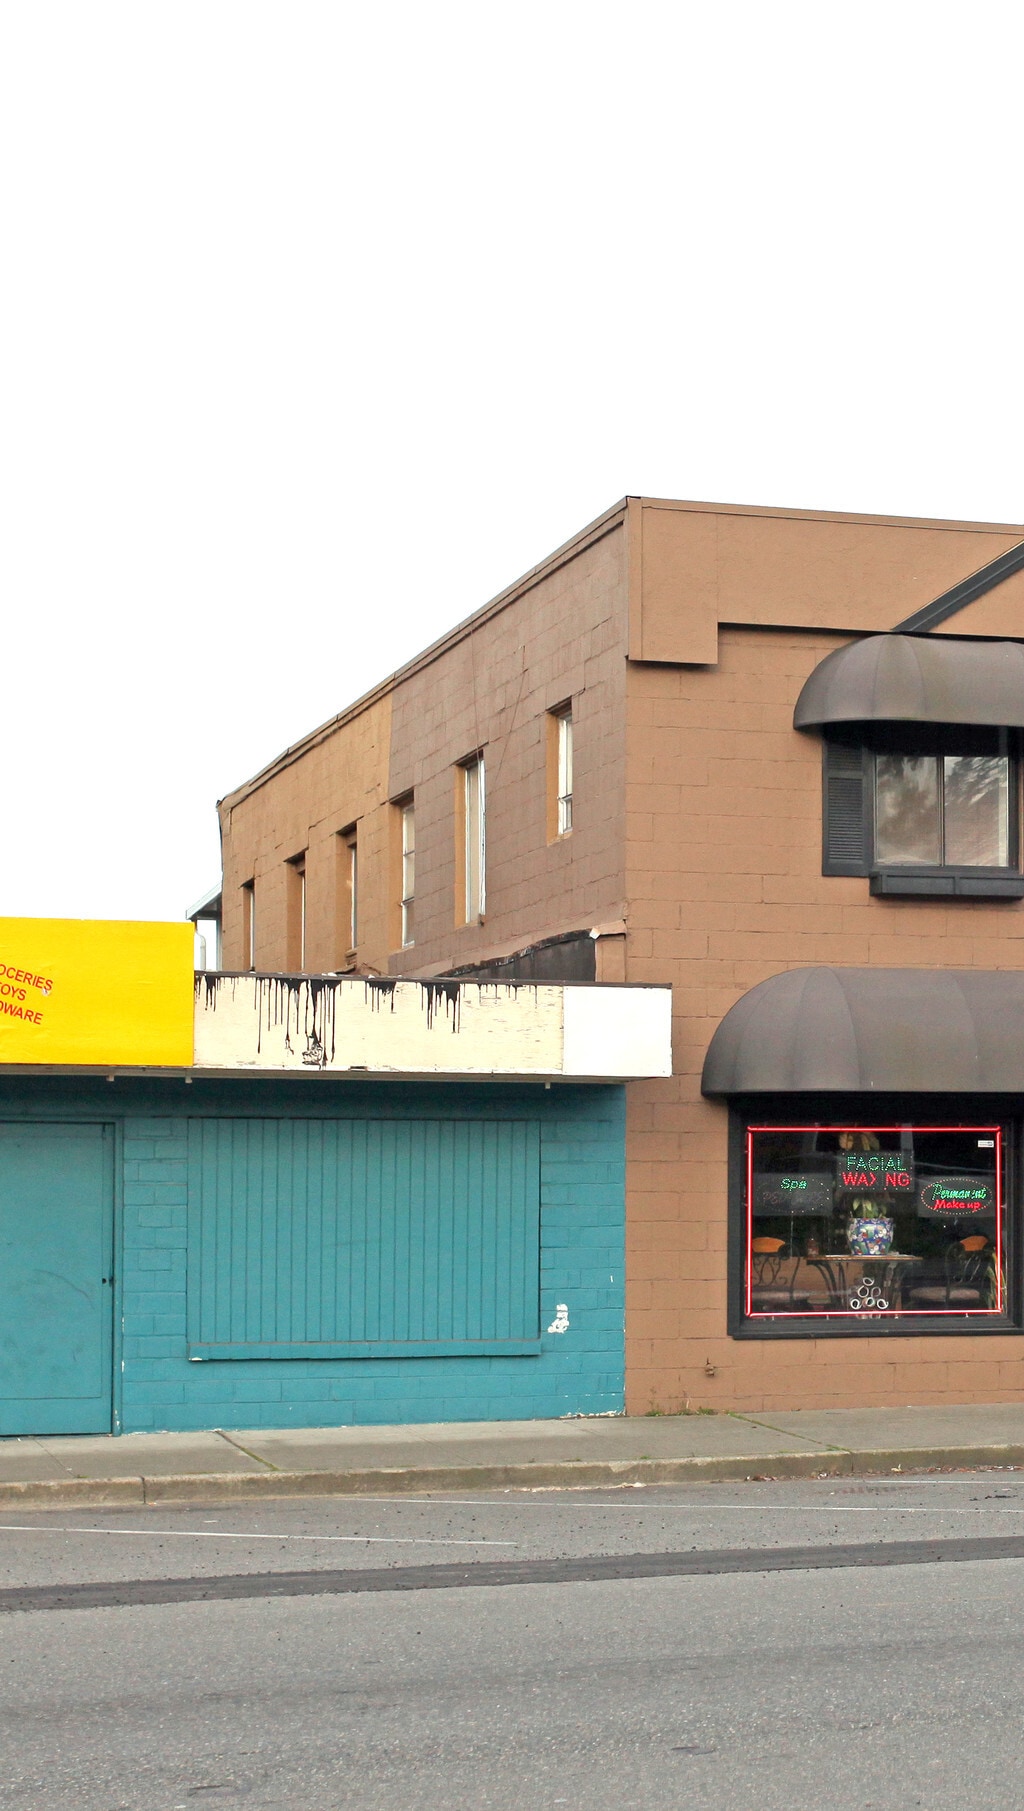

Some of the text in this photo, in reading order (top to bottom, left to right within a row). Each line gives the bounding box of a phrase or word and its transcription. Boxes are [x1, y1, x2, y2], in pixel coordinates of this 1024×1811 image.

[0, 981, 27, 1001] OYS
[846, 1156, 907, 1171] FACIAL
[780, 1177, 808, 1192] Spa
[841, 1171, 910, 1187] WAXNG
[933, 1198, 982, 1212] Make up
